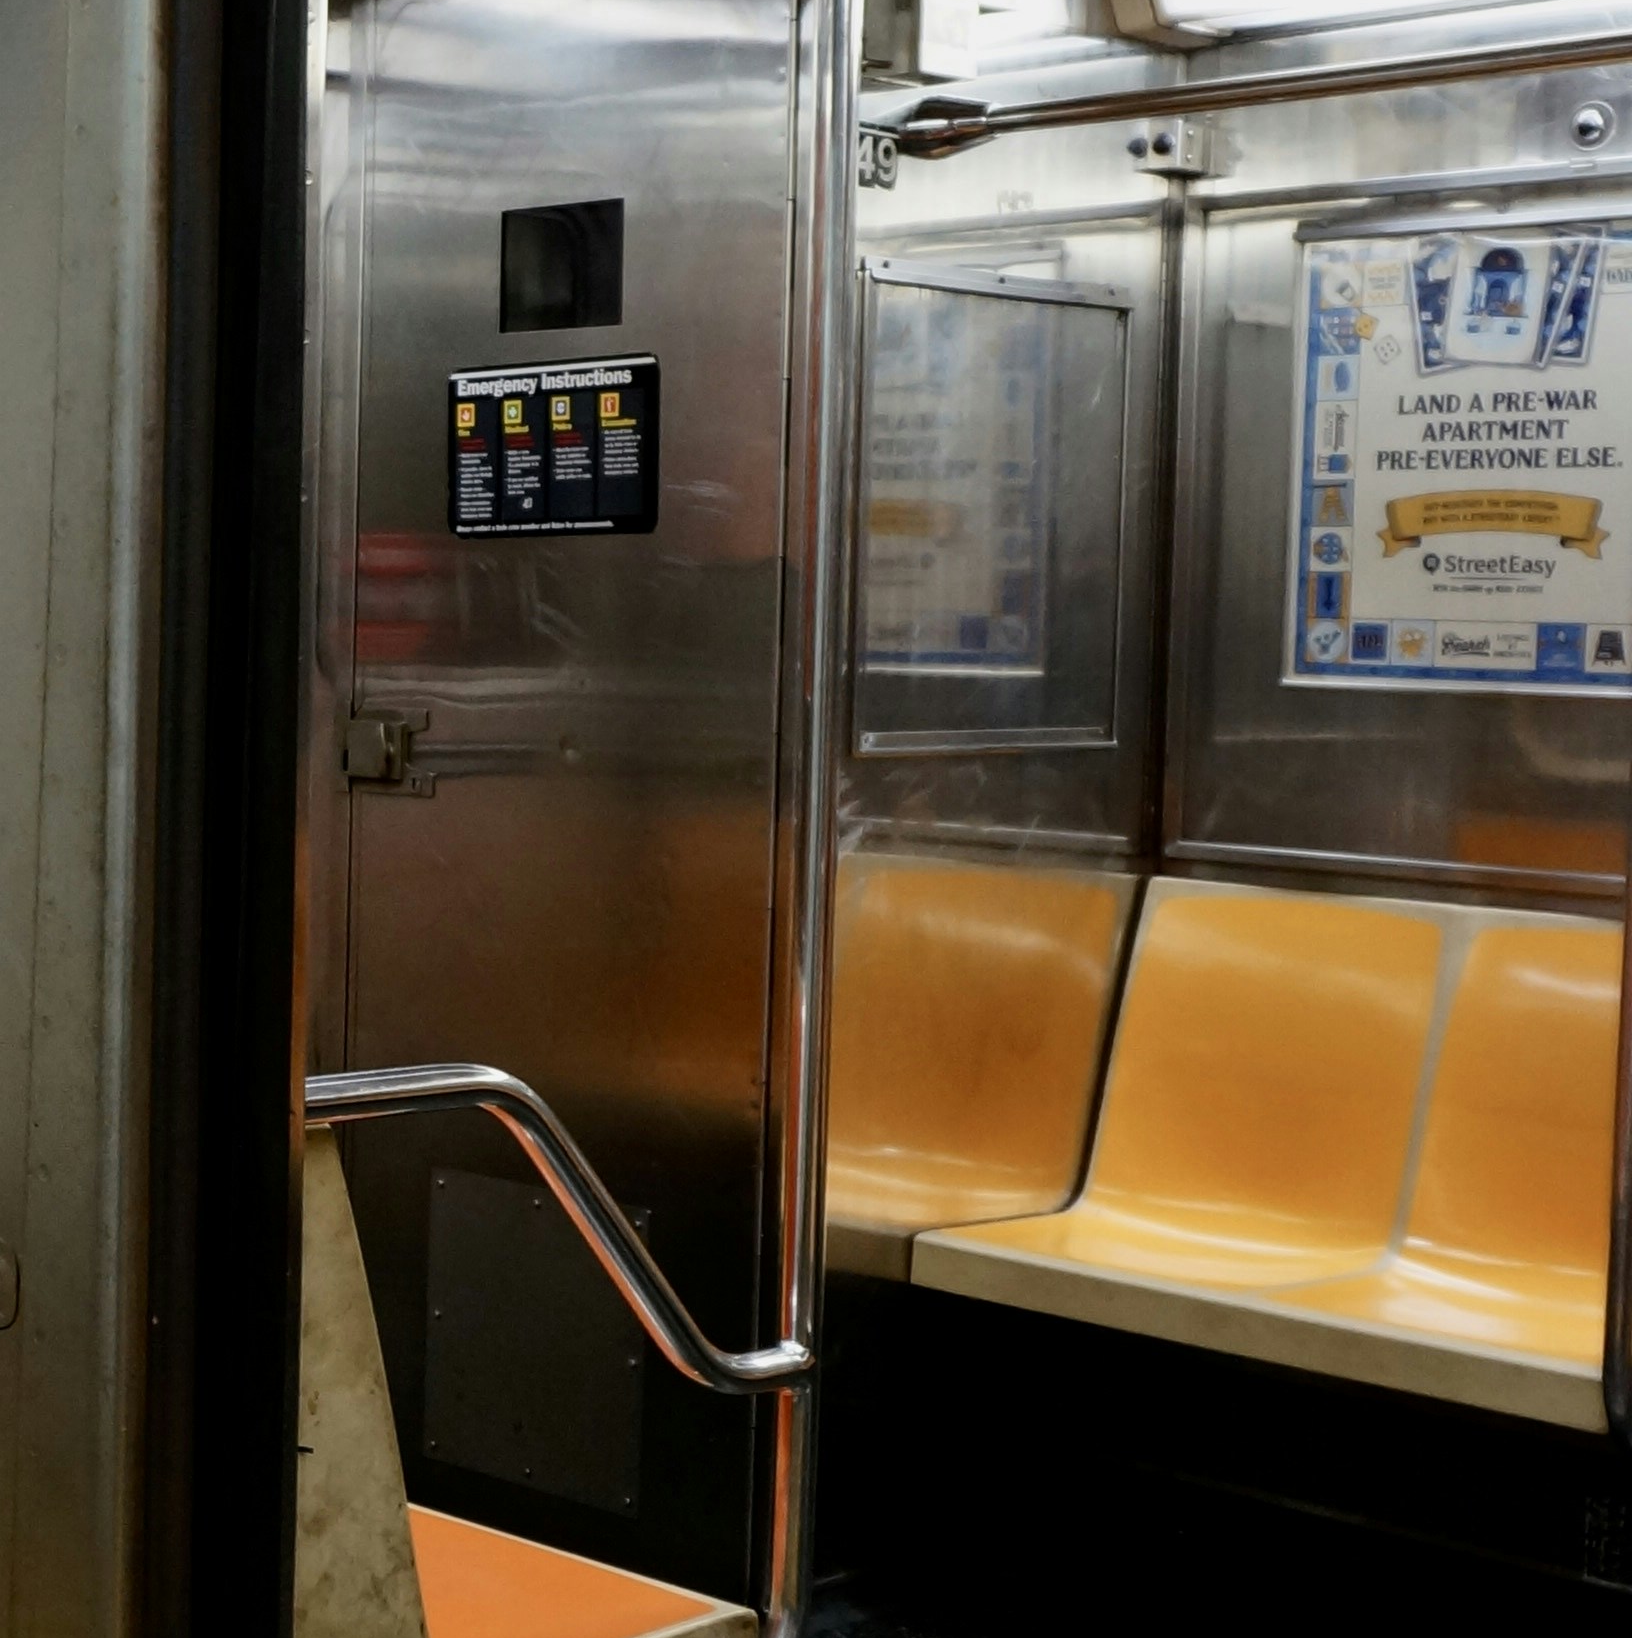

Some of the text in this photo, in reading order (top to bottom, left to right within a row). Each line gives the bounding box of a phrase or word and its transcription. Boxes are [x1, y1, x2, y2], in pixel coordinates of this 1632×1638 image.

[456, 368, 633, 399] Emergency Instructions
[1397, 389, 1598, 416] LAND A PRE-WAR
[1421, 419, 1570, 443] APARTMENT
[1376, 446, 1624, 471] PRE-EVERYONE ELSE.
[1444, 553, 1556, 579] StreetEasy
